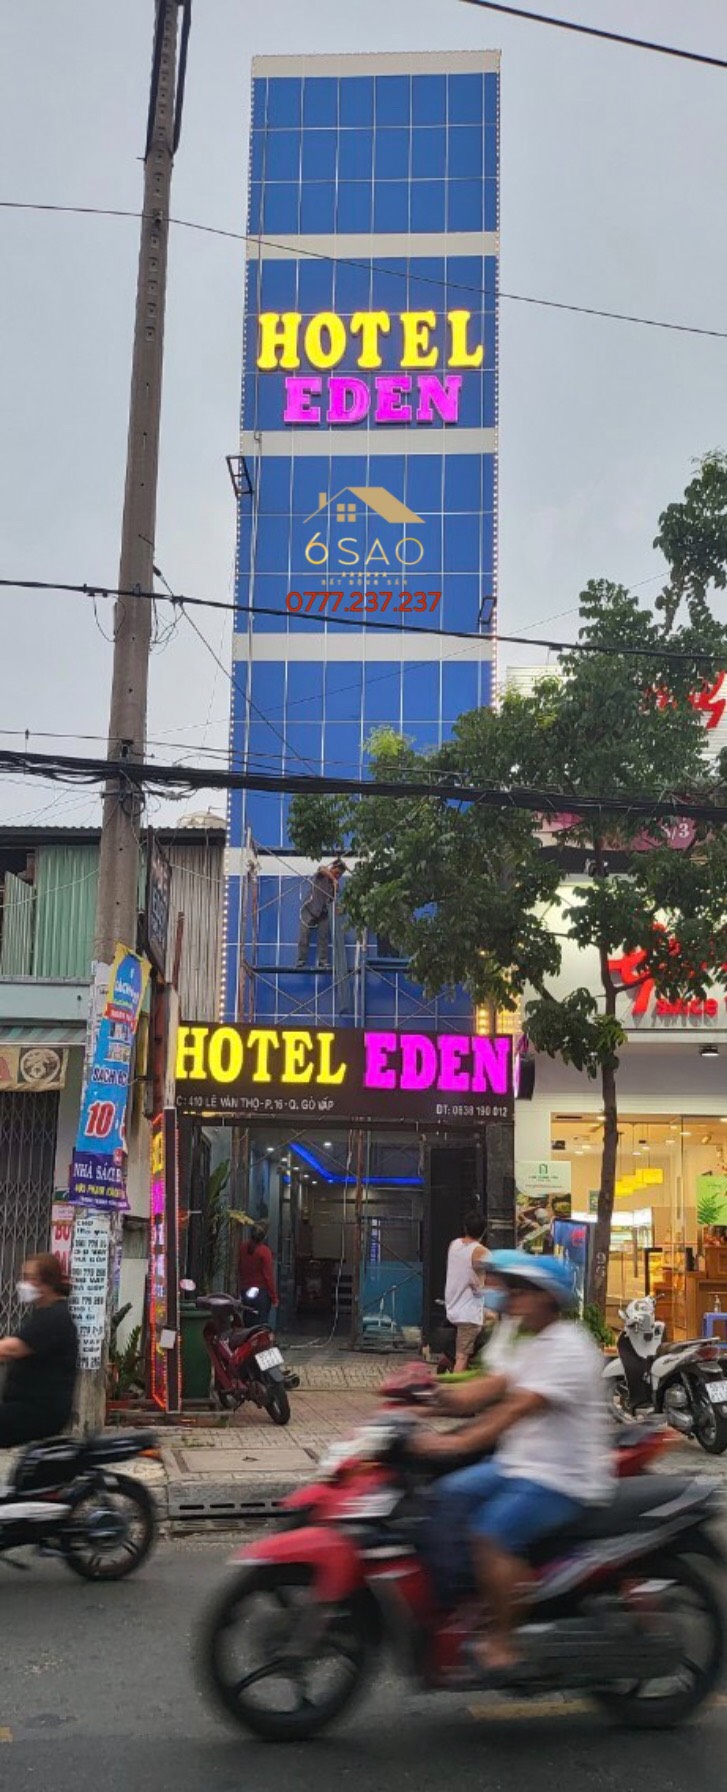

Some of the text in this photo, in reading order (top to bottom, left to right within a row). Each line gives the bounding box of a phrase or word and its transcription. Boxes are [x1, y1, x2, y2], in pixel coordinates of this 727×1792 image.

[257, 310, 484, 371] HOTEL
[283, 375, 462, 425] EDEN
[176, 1026, 509, 1094] HOTEL EDEN
